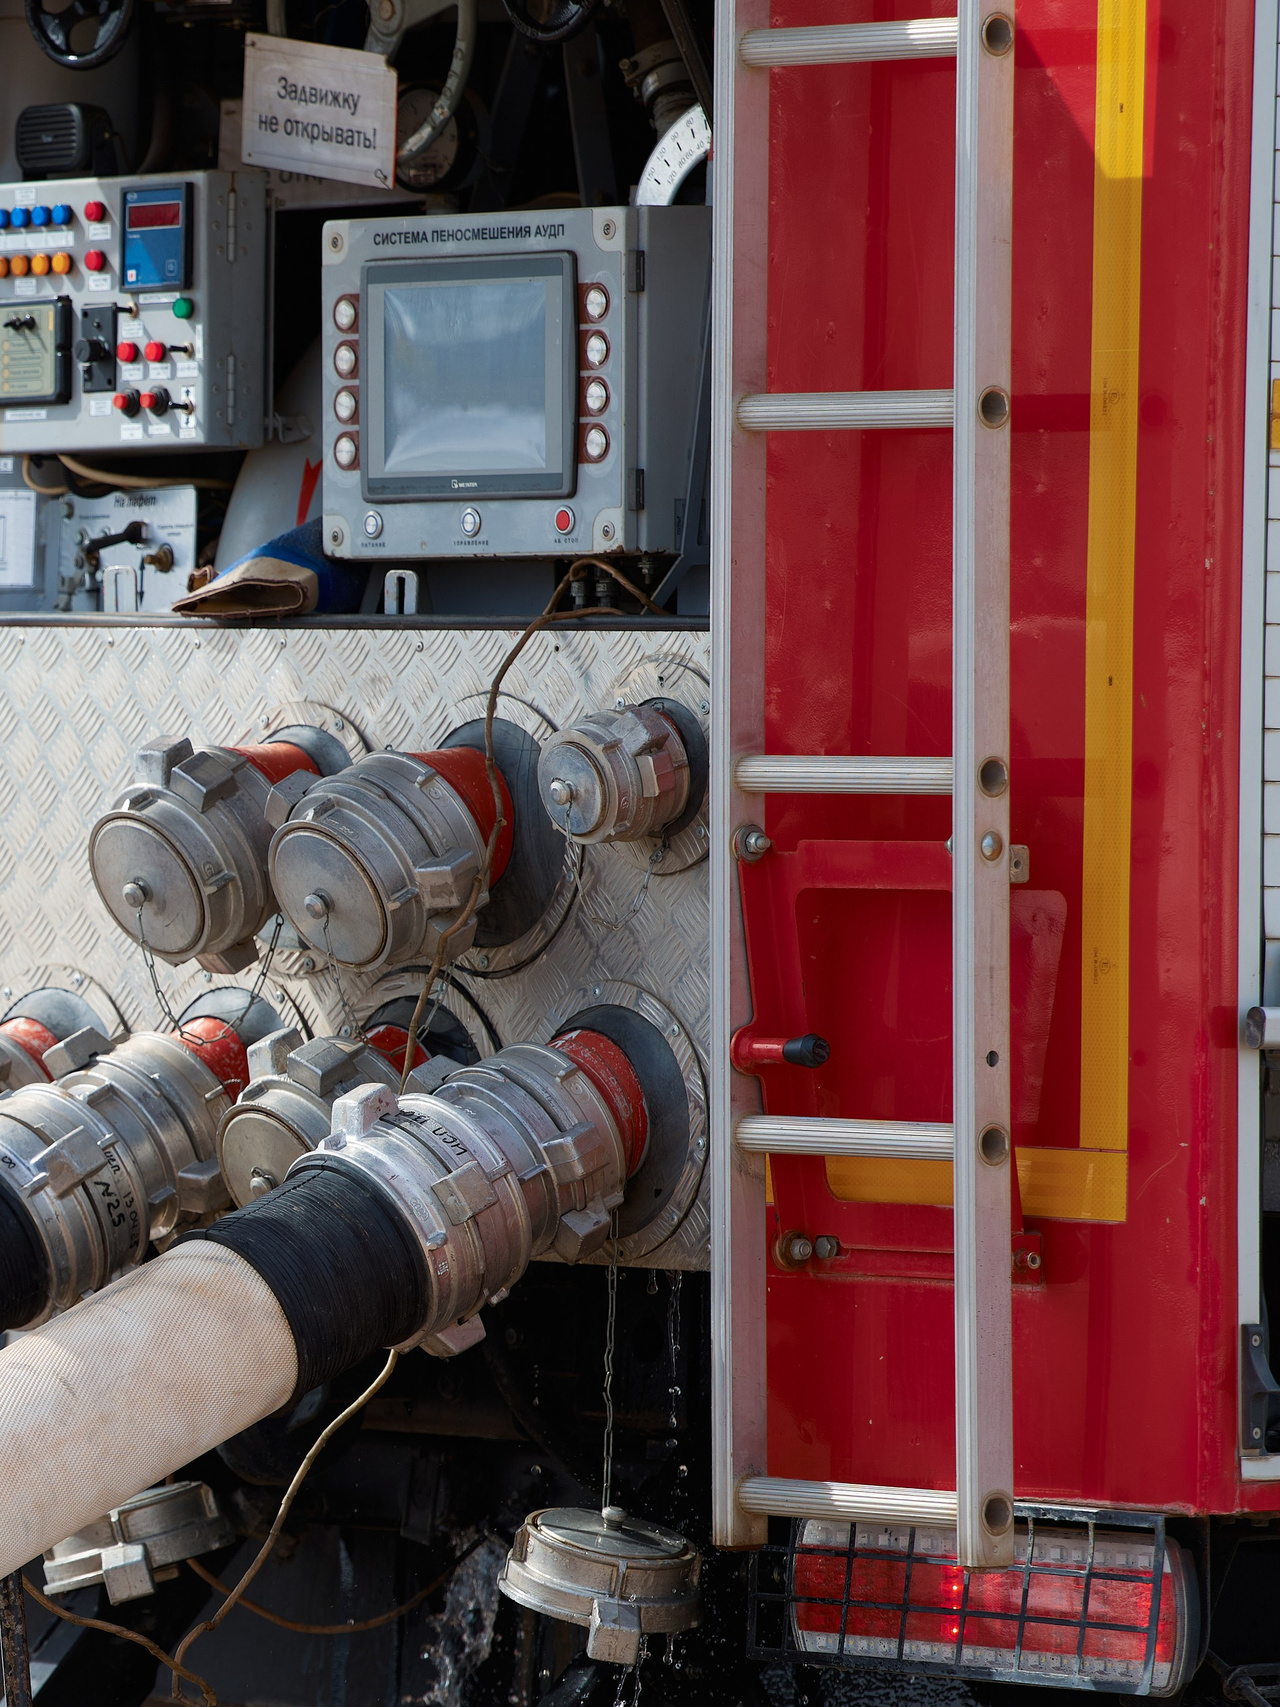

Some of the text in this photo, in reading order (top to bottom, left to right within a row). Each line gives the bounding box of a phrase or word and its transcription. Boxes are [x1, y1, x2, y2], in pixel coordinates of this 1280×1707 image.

[277, 76, 361, 115] Задвижку
[258, 114, 377, 150] не открывать!
[373, 223, 565, 246] СИСТЕМА ПЕНОСМЕШЕНИЯ АУДП
